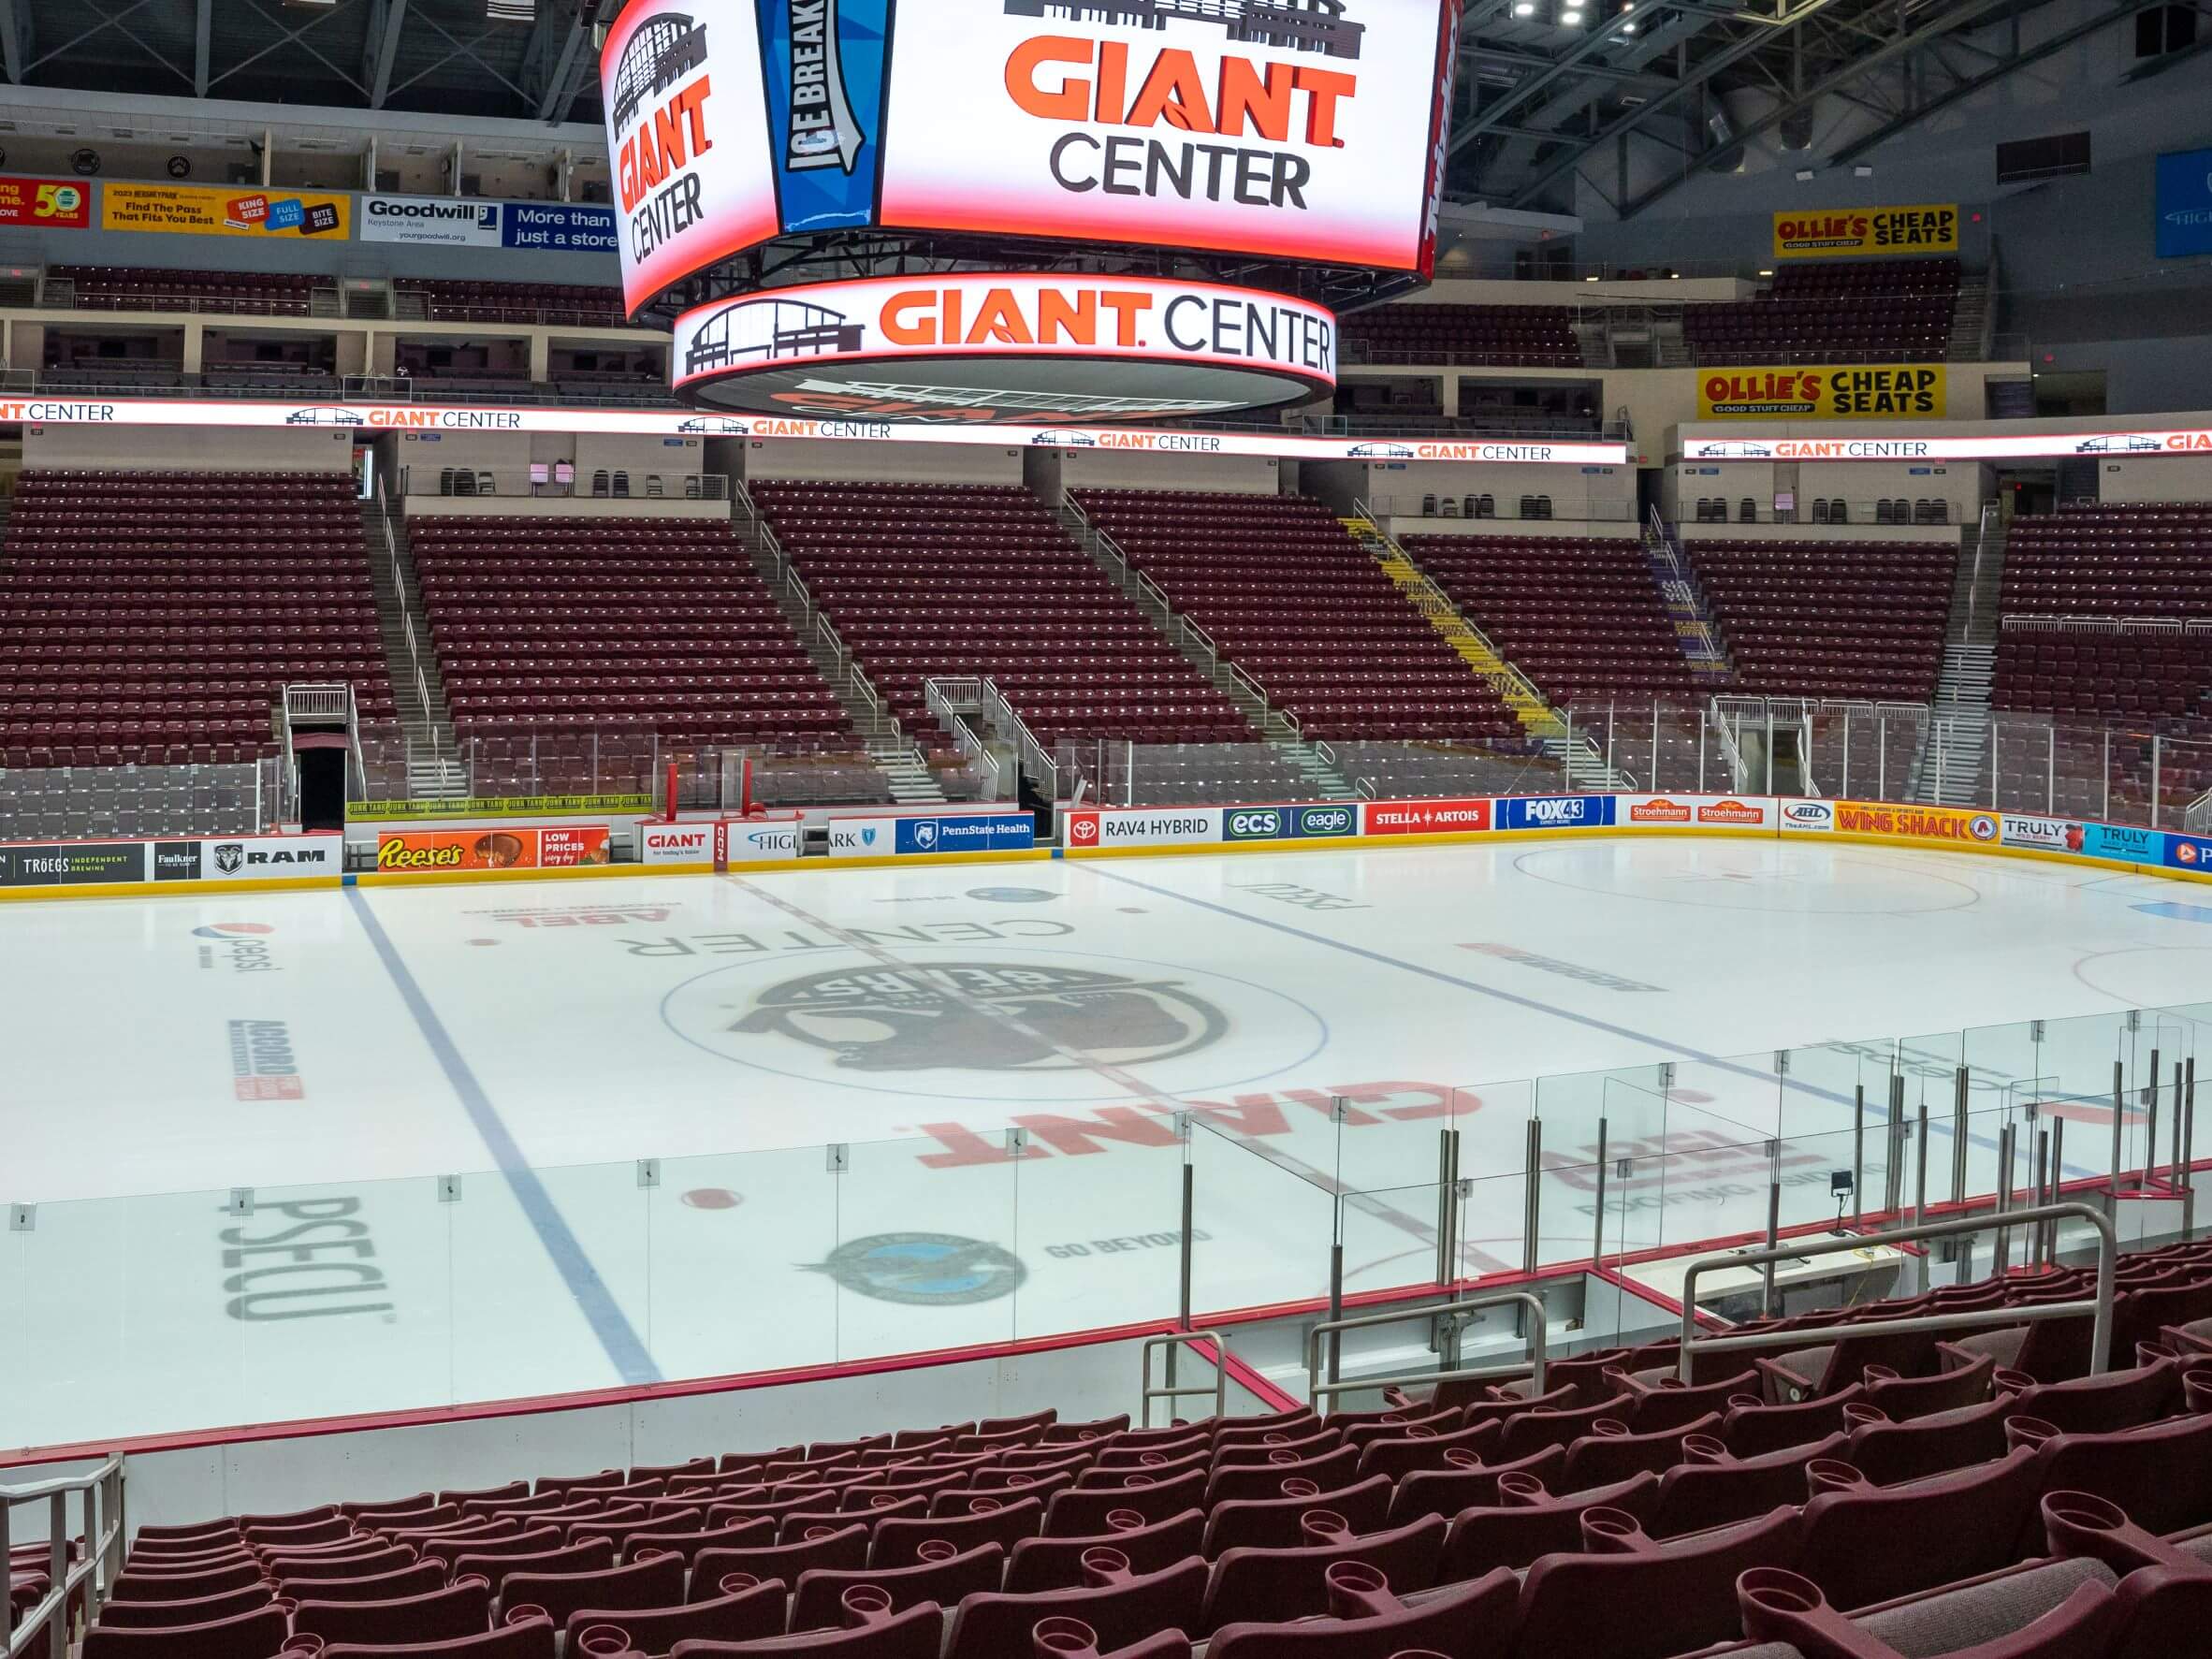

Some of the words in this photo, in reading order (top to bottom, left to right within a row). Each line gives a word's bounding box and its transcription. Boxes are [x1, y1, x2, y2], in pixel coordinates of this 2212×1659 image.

[1004, 35, 1357, 147] GIANT
[619, 75, 712, 214] GIANT
[788, 109, 841, 170] ICE
[1049, 133, 1310, 210] CENTER
[125, 202, 150, 211] Find
[153, 203, 174, 213] The
[176, 205, 201, 213] Pass
[238, 197, 264, 211] KING
[276, 204, 299, 215] FULL
[368, 200, 474, 221] Goodwill
[112, 211, 139, 222] That
[142, 212, 163, 223] Fits
[166, 214, 186, 224] You
[189, 215, 214, 225] Best
[241, 208, 265, 219] SIZE
[279, 212, 299, 224] SIZE
[312, 208, 333, 220] BITE
[313, 216, 334, 227] SIZE
[517, 209, 565, 225] More
[571, 211, 609, 227] than
[632, 172, 704, 264] CENTER
[1872, 211, 1955, 229] CHEAP
[515, 228, 549, 245] just
[554, 233, 566, 244] a
[571, 231, 618, 247] store
[1875, 226, 1953, 245] SEATS
[880, 288, 1152, 348] GIANT
[1164, 295, 1332, 374] CENTER
[1830, 371, 1936, 392] CHEAP
[1749, 404, 1778, 413] STUFF
[1833, 391, 1934, 414] SEATS
[29, 404, 113, 421] CENTER
[369, 411, 440, 427] GIANT
[444, 412, 520, 429] CENTER
[752, 420, 818, 436] GIANT
[821, 422, 891, 439] CENTER
[1099, 433, 1157, 449] GIANT
[1158, 435, 1220, 452] CENTER
[1776, 443, 1845, 457] GIANT
[1849, 442, 1928, 457] CENTER
[1418, 444, 1481, 459] GIANT
[1483, 445, 1552, 461] CENTER
[1306, 810, 1346, 829] eagle
[1376, 811, 1420, 825] STELLA
[1434, 809, 1478, 823] ARTOIS
[1633, 807, 1687, 817] Stroehmann
[1701, 807, 1759, 819] Stroehmann
[1792, 807, 1822, 818] AHL
[997, 822, 1030, 834] Health
[1106, 821, 1145, 837] RAV4
[1151, 818, 1208, 835] HYBRID
[1233, 813, 1276, 833] ecs
[1838, 809, 1894, 832] WING
[1898, 813, 1969, 838] SHACK
[2004, 820, 2062, 837] TRULY
[546, 833, 570, 842] LOW
[647, 833, 706, 848] GIANT
[2101, 827, 2148, 844] TRULY
[378, 838, 464, 867] Reese's
[546, 842, 585, 852] PRICES
[158, 854, 197, 863] Faulkner
[247, 850, 326, 864] RAM
[615, 919, 1076, 957] CENTER
[219, 939, 284, 973] pepsi
[913, 1081, 1483, 1170] GIANT
[218, 1197, 395, 1321] PSECU
[1044, 1243, 1091, 1259] GO
